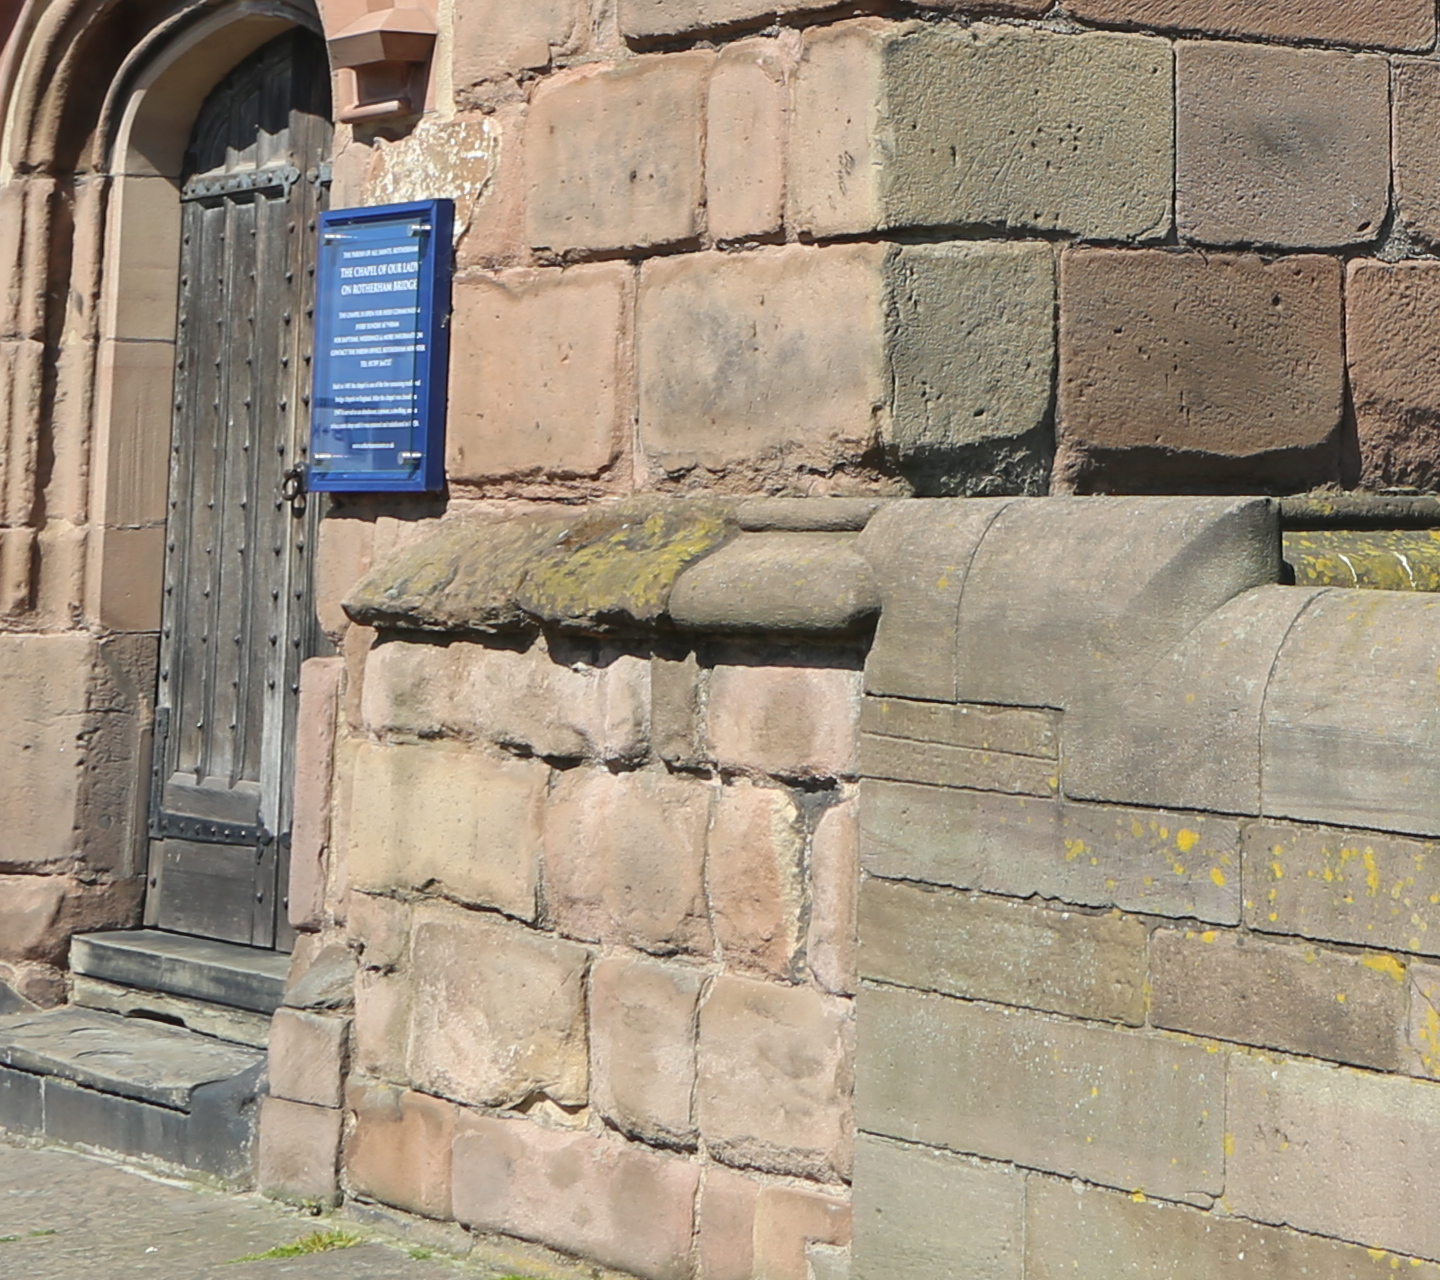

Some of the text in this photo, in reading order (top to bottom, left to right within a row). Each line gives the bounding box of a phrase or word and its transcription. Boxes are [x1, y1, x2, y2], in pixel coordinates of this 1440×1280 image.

[340, 267, 353, 278] THE
[354, 266, 377, 277] CHAPEL
[378, 264, 388, 275] OF
[388, 262, 402, 274] OUR
[341, 278, 418, 295] ON ROTHERHAM BRIDGE
